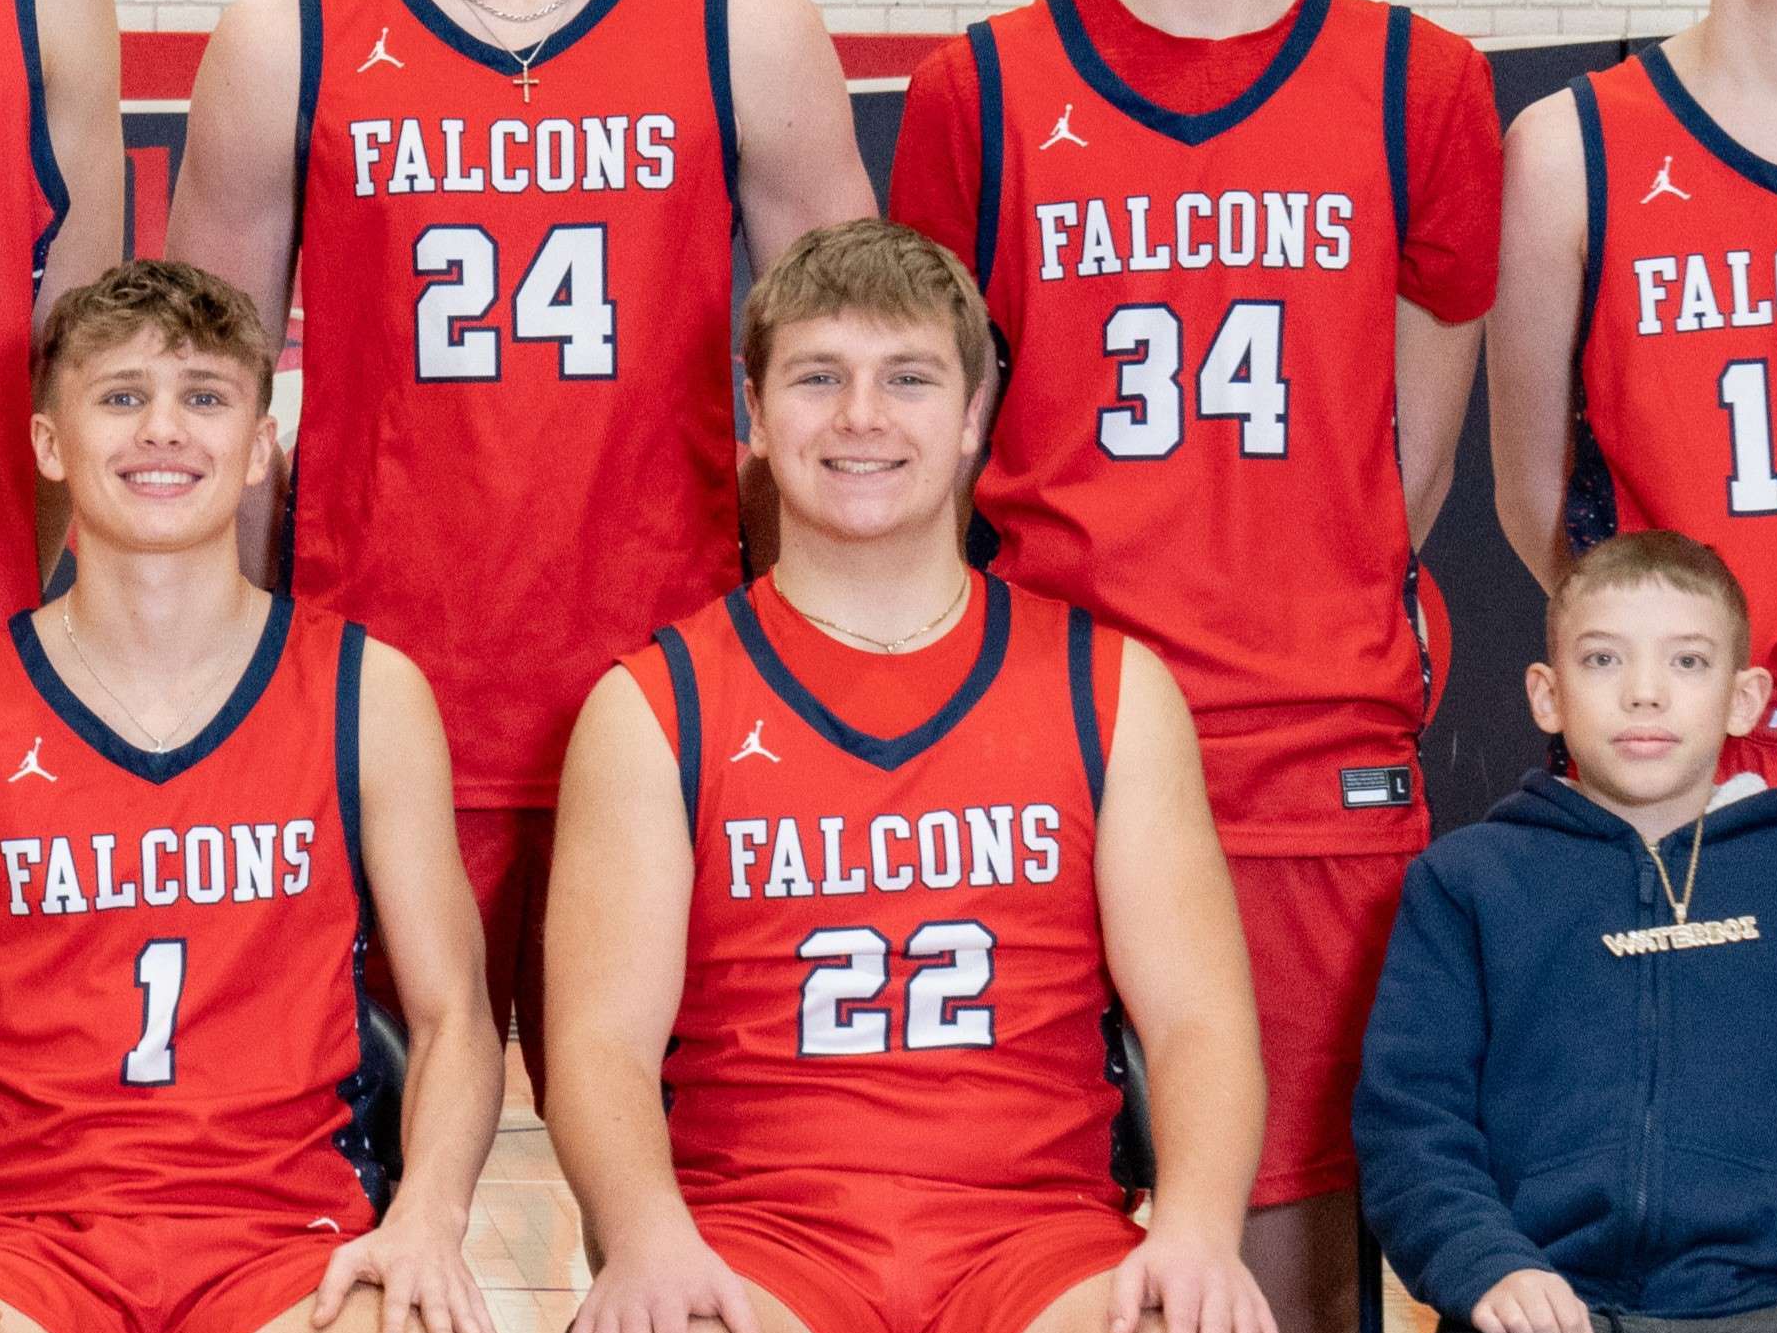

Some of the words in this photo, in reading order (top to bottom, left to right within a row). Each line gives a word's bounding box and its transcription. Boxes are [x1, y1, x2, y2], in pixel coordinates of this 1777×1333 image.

[349, 114, 677, 197] FALCONS
[1035, 190, 1355, 282] FALCONS
[412, 222, 618, 384] 24
[1097, 298, 1290, 462] 34
[1396, 777, 1406, 794] L
[723, 802, 1062, 900] FALCONS
[120, 938, 188, 1087] 1
[797, 918, 996, 1059] 22
